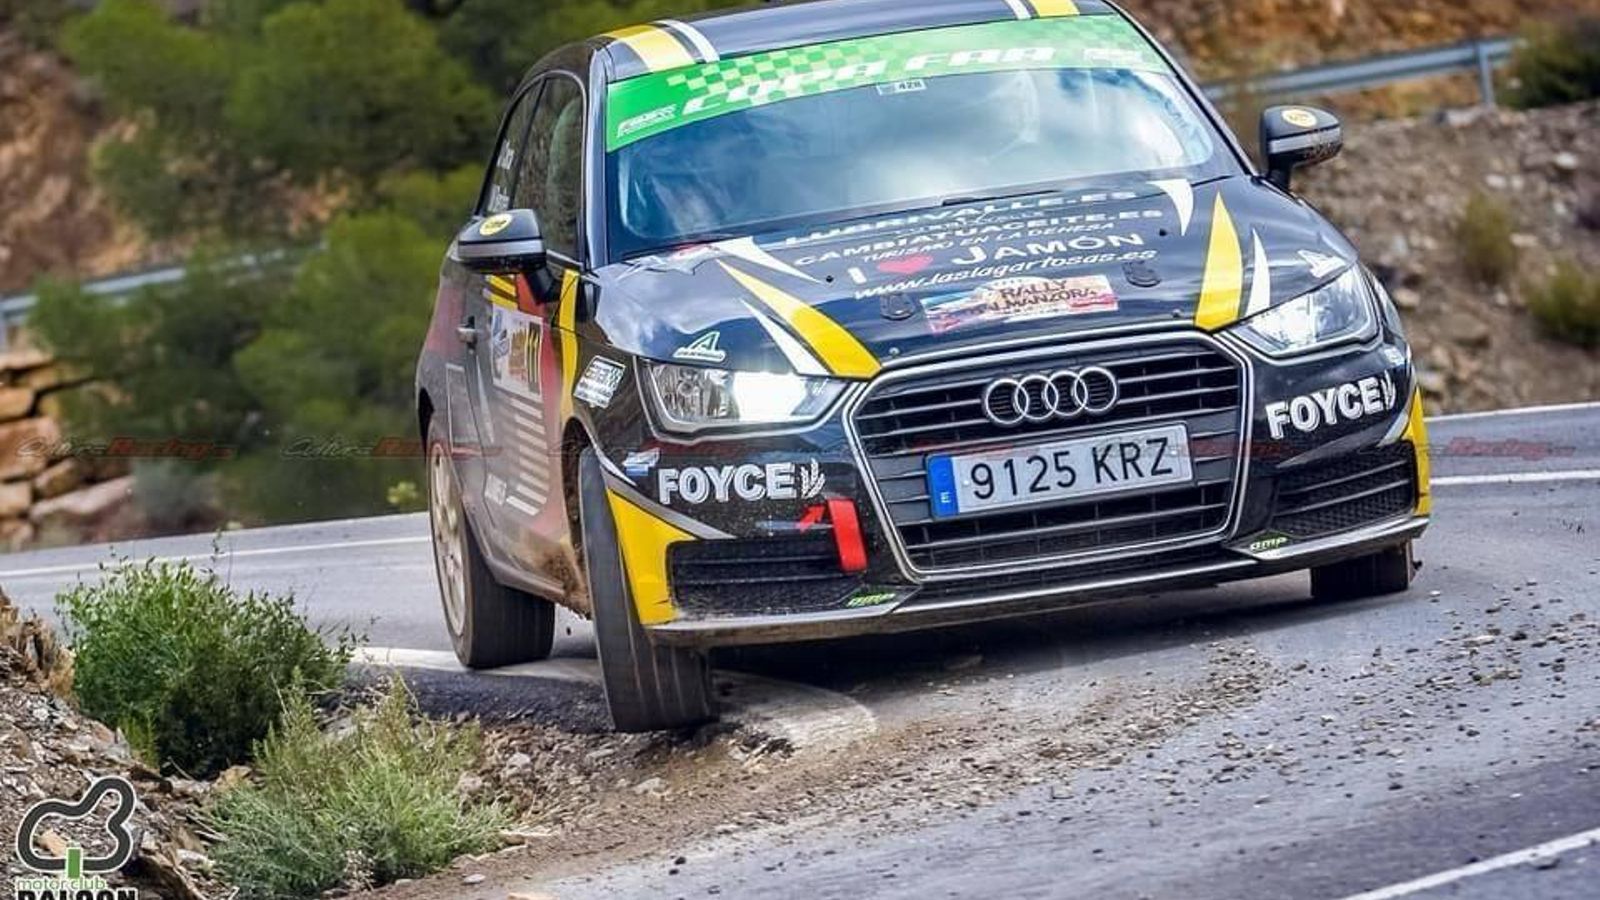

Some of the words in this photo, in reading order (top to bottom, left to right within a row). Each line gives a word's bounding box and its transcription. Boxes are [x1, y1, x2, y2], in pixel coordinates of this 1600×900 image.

[794, 210, 1163, 266] CAMBIATUACEITE.ES
[854, 249, 1157, 300] www.laslagartosas.es
[1265, 376, 1382, 440] FOYCE
[658, 462, 797, 504] FOYCE
[970, 450, 1077, 500] 9125
[1091, 437, 1173, 485] KRZ
